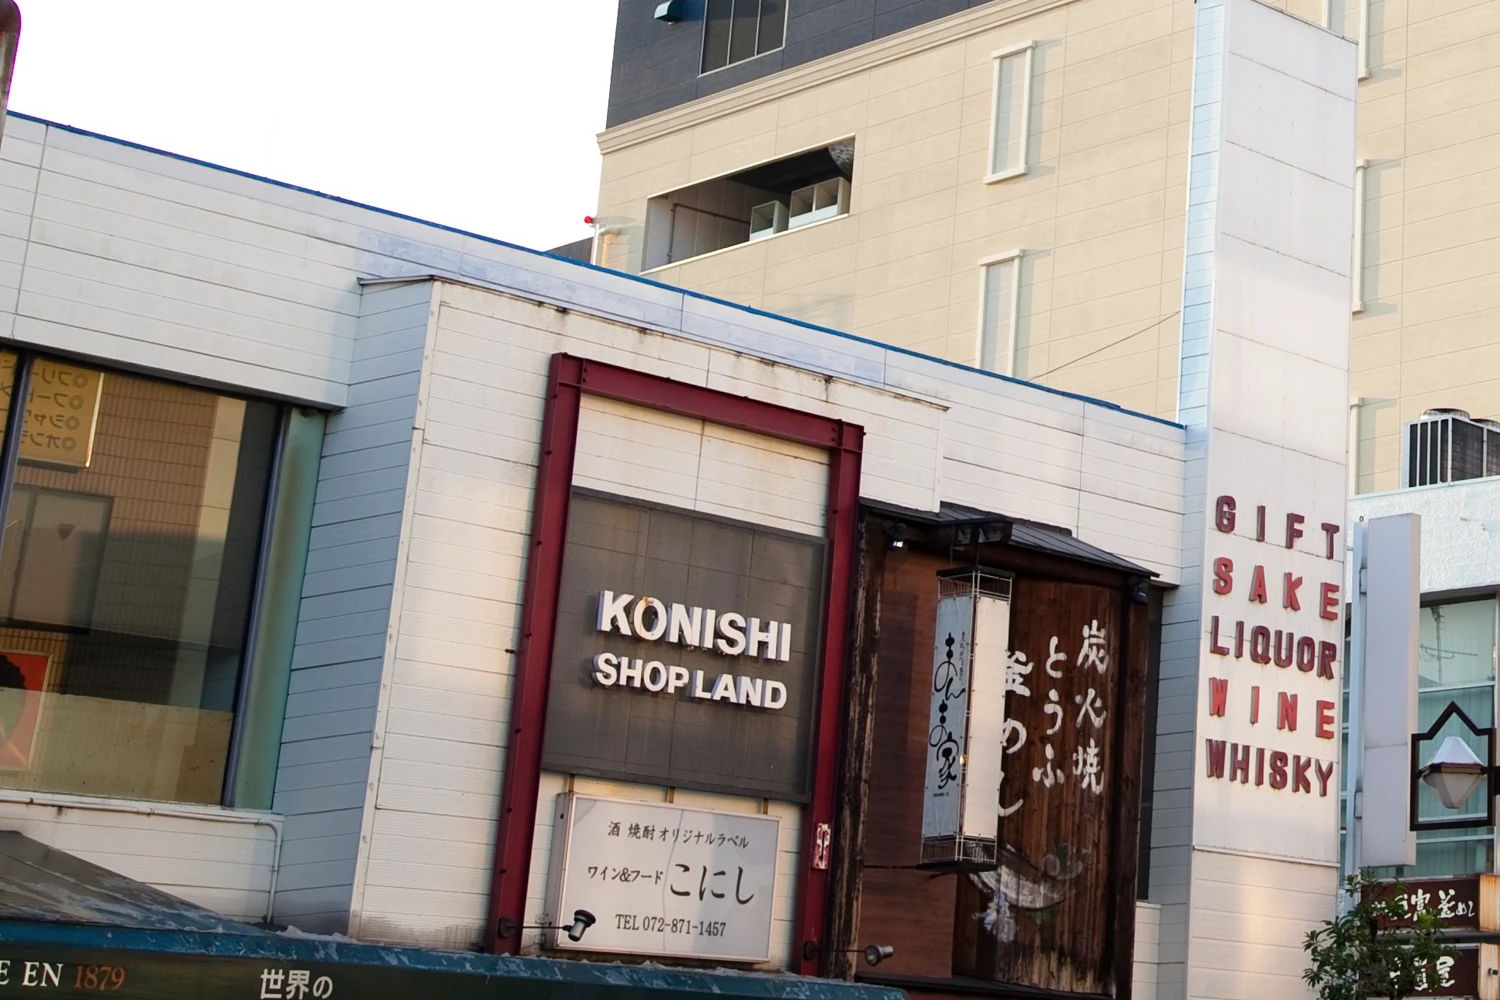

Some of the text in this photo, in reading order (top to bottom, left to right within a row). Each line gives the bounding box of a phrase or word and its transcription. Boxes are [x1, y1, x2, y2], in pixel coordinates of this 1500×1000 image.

[1214, 494, 1340, 560] GIFT
[1212, 556, 1340, 621] SAKE
[596, 589, 792, 662] KONISHI
[1209, 614, 1337, 680] LIQUOR
[592, 652, 788, 710] SHOP LAND
[1071, 618, 1110, 796] 炭火焼
[1208, 676, 1336, 740] WINE
[1031, 635, 1067, 789] とうふ
[1205, 738, 1334, 797] WHISKY
[607, 821, 622, 838] 酒
[587, 862, 755, 905] ワイン&フード こにし
[615, 913, 727, 938] TEL 072-871-1457
[22, 961, 64, 987] EN
[73, 965, 126, 991] 1879
[259, 967, 334, 1000] 世界の
